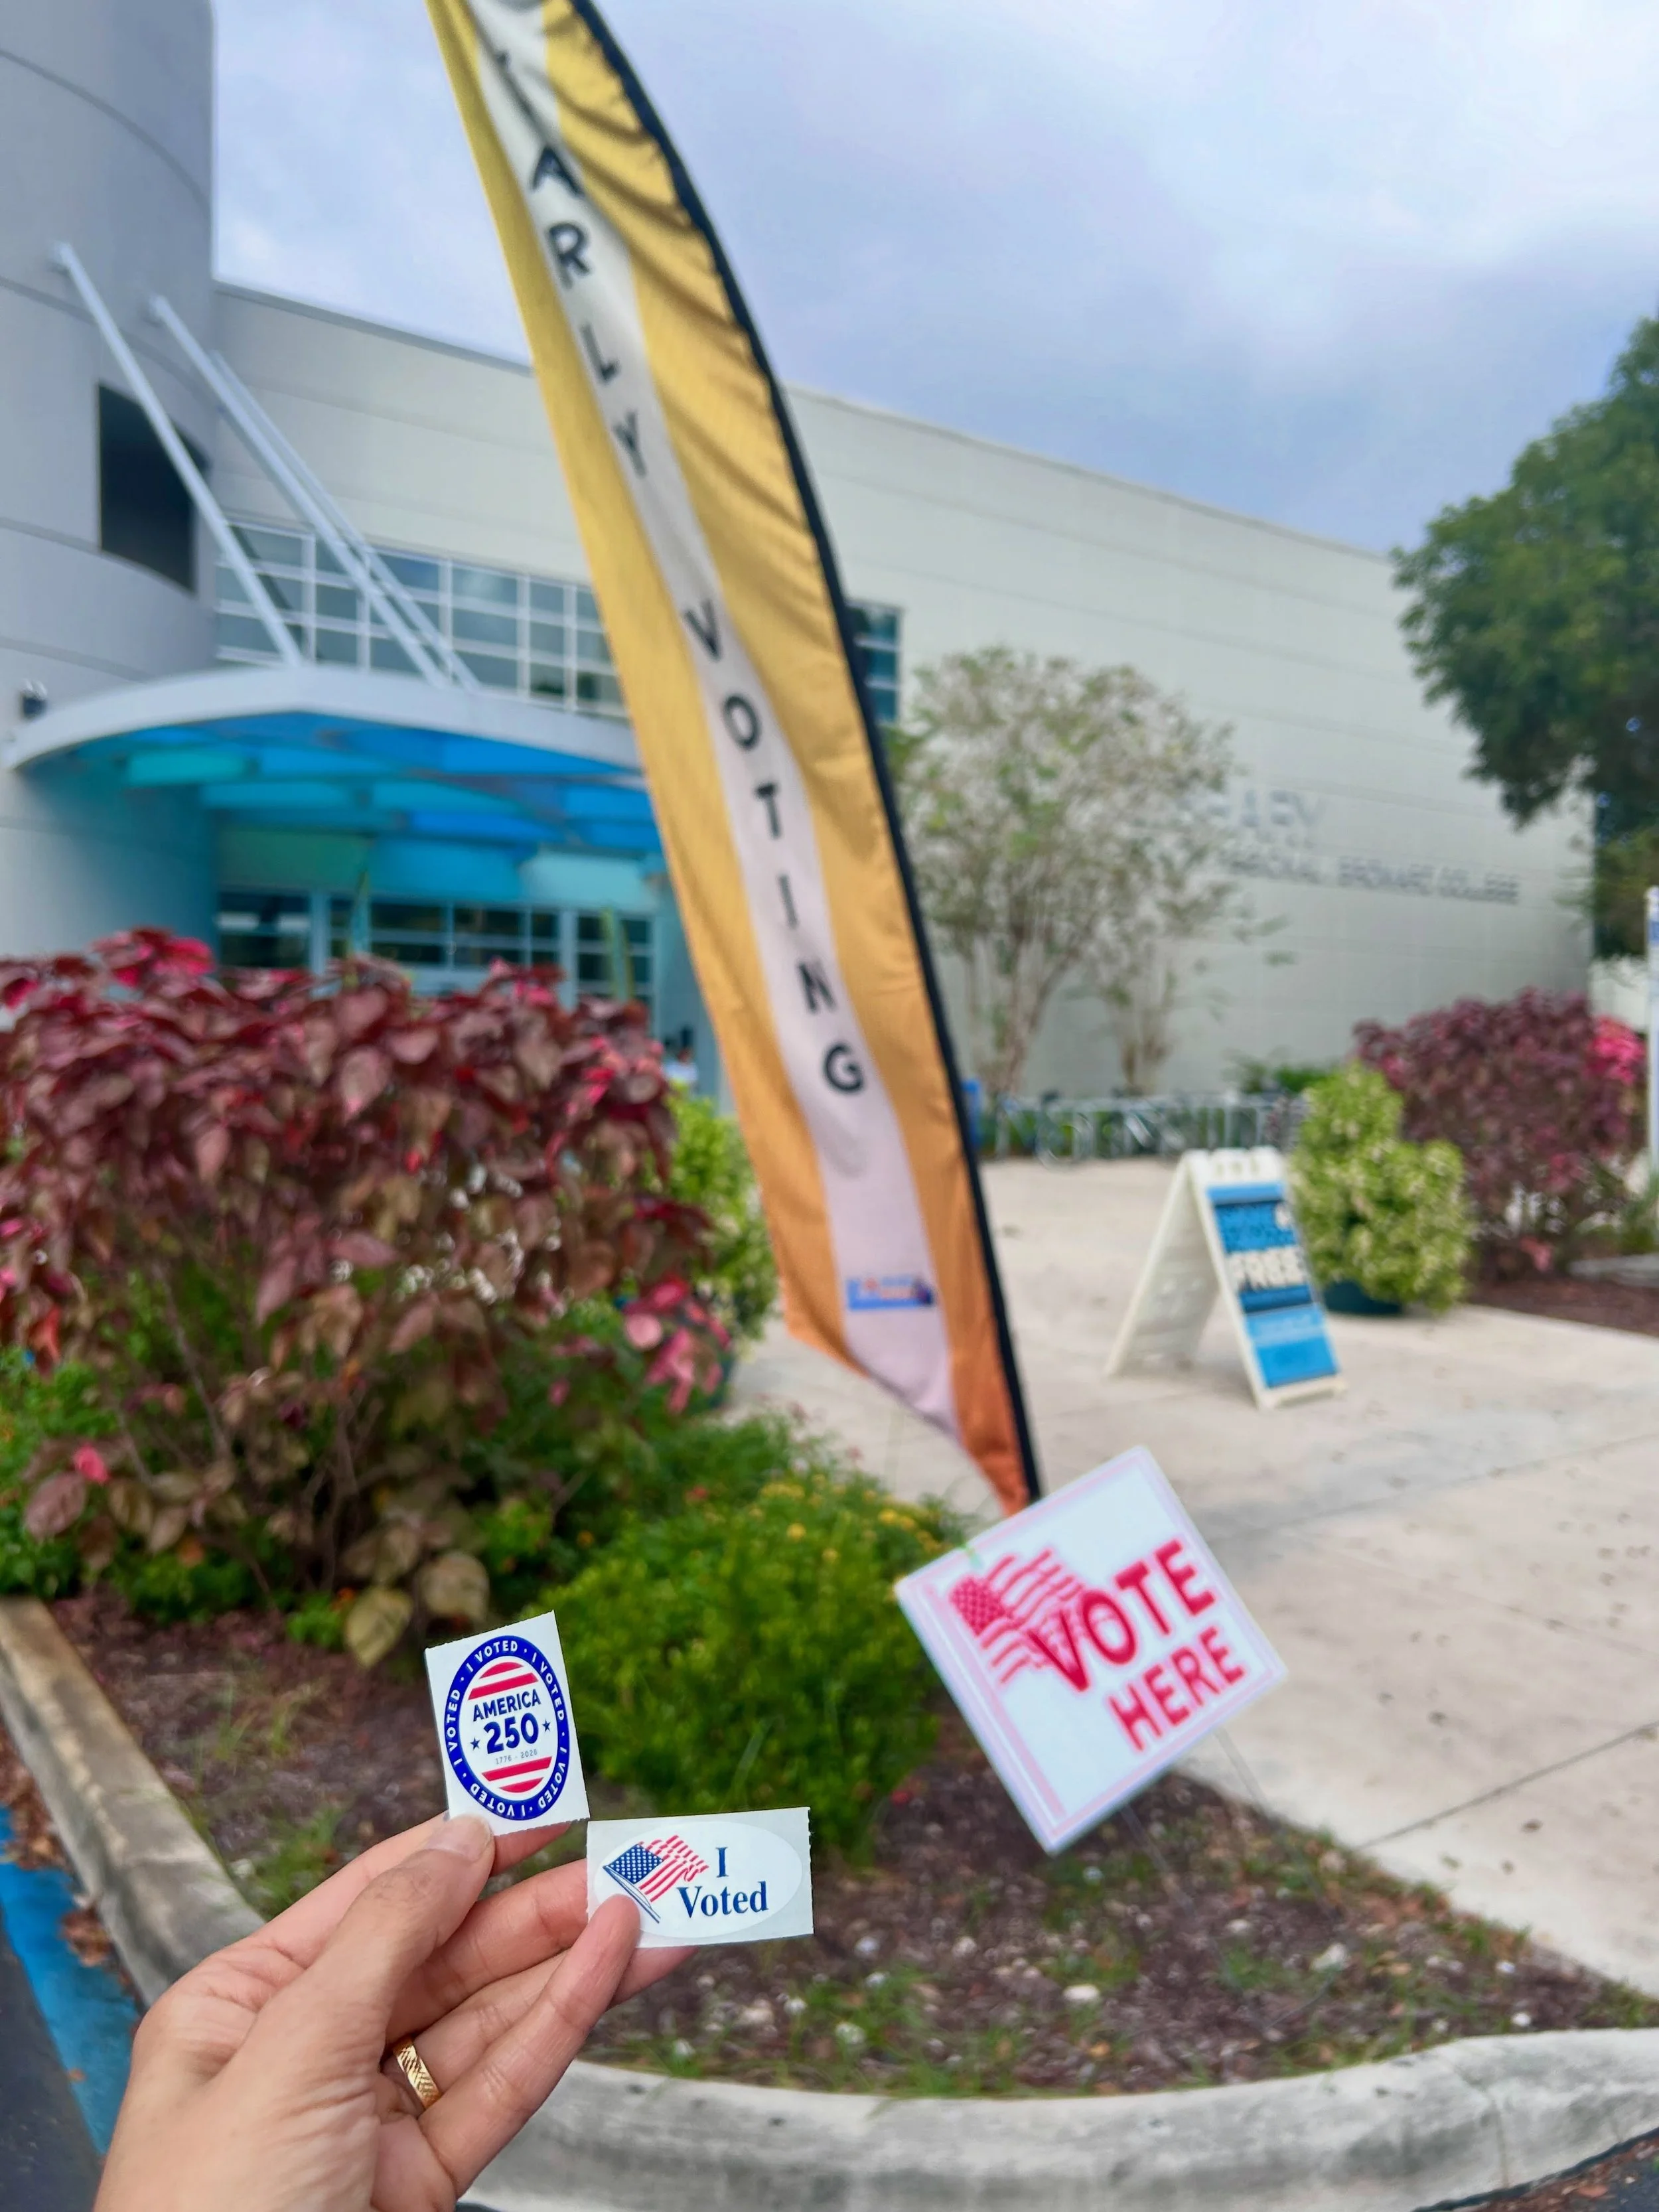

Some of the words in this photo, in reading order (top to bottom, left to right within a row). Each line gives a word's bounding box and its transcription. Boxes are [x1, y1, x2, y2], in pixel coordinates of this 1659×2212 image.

[496, 50, 646, 479] ARLY
[684, 600, 865, 1094] VOTING
[1027, 1539, 1216, 1692] VOTE
[466, 1662, 474, 1672] I
[474, 1640, 518, 1662] VOTED
[473, 1688, 541, 1722] AMERICA
[532, 1652, 537, 1663] I
[540, 1660, 565, 1722] VOTED
[1108, 1627, 1246, 1751] HERE
[446, 1688, 461, 1752] VOTED
[483, 1712, 539, 1754] 250
[496, 1755, 512, 1765] 1776
[470, 1783, 515, 1816] VOTED
[538, 1762, 566, 1808] VOTED
[521, 1805, 526, 1816] I
[715, 1846, 729, 1878] I
[676, 1881, 769, 1919] Voted
